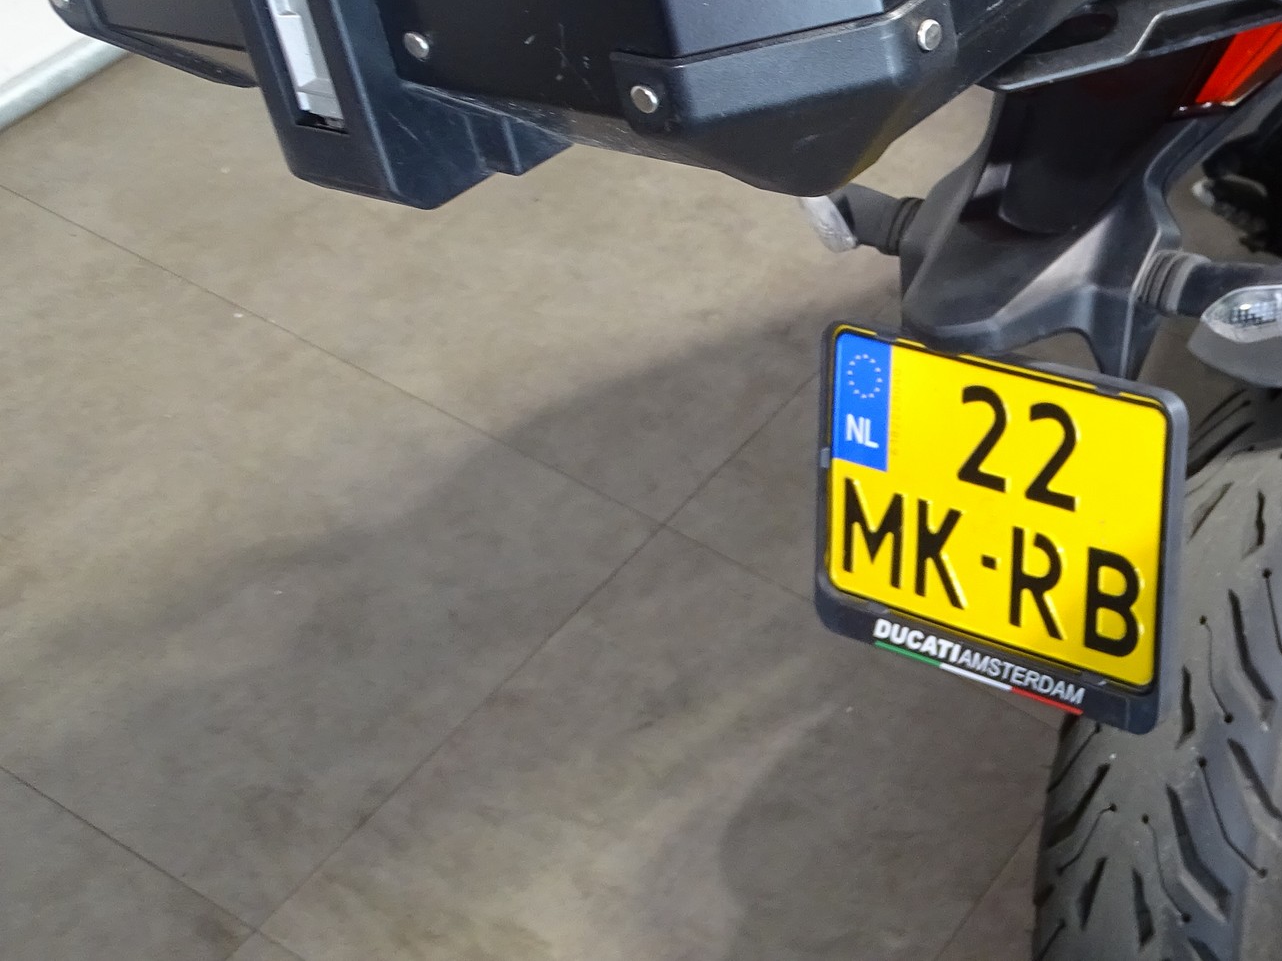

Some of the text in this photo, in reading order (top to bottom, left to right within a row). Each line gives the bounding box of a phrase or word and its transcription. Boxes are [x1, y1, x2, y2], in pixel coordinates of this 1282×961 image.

[845, 413, 879, 449] NL
[957, 384, 1080, 512] 22
[842, 476, 1143, 658] MK-RB
